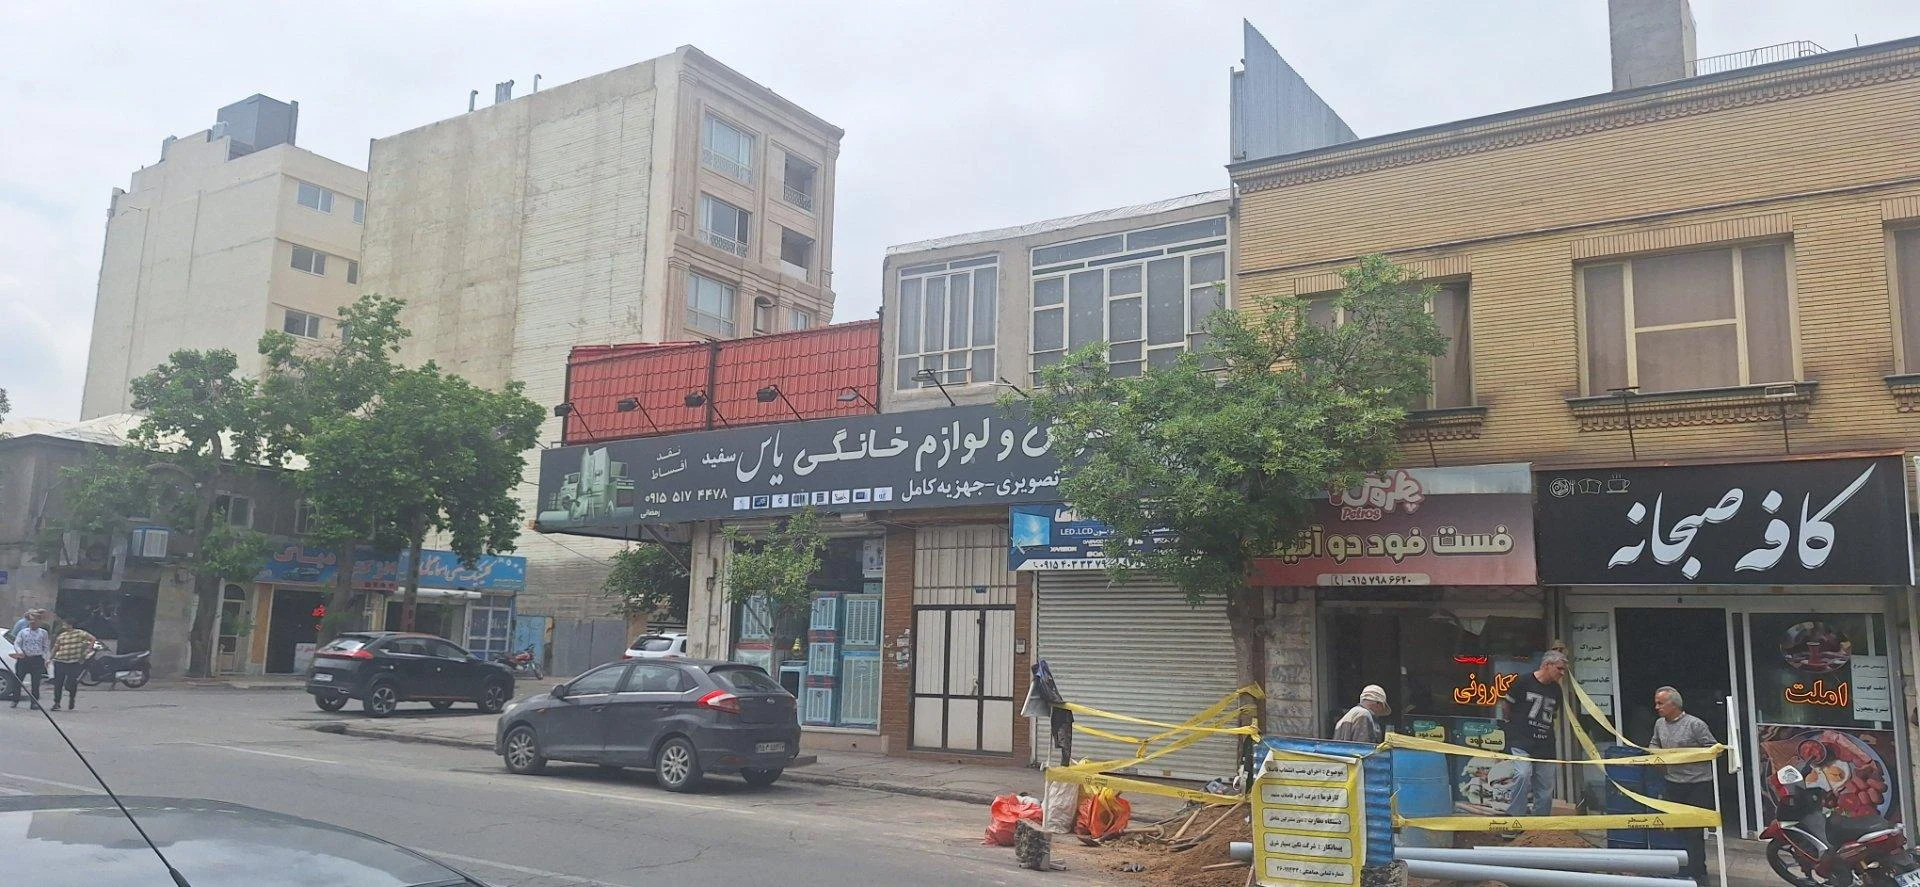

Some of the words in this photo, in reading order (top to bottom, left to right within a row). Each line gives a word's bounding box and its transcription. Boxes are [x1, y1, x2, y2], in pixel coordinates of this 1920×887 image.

[656, 445, 681, 461] نقد
[702, 448, 736, 468] سفید
[736, 429, 784, 487] یاس
[793, 426, 909, 476] خانگی
[915, 417, 990, 472] لوازم
[997, 429, 1014, 461] و
[651, 458, 688, 480] اقساط
[645, 492, 667, 504] ۰۹۱۵
[672, 490, 692, 503] ۵۱۷
[697, 487, 728, 501] ۴۴۷۸
[901, 477, 937, 502] کامل
[1341, 507, 1381, 520] Petros
[1735, 462, 1877, 573] کافه
[1326, 533, 1363, 565] دو
[1366, 527, 1428, 565] فود
[1431, 524, 1515, 556] فست
[1608, 487, 1744, 581] صبحانه
[1527, 691, 1556, 723] 75
[1785, 680, 1848, 707] املت
